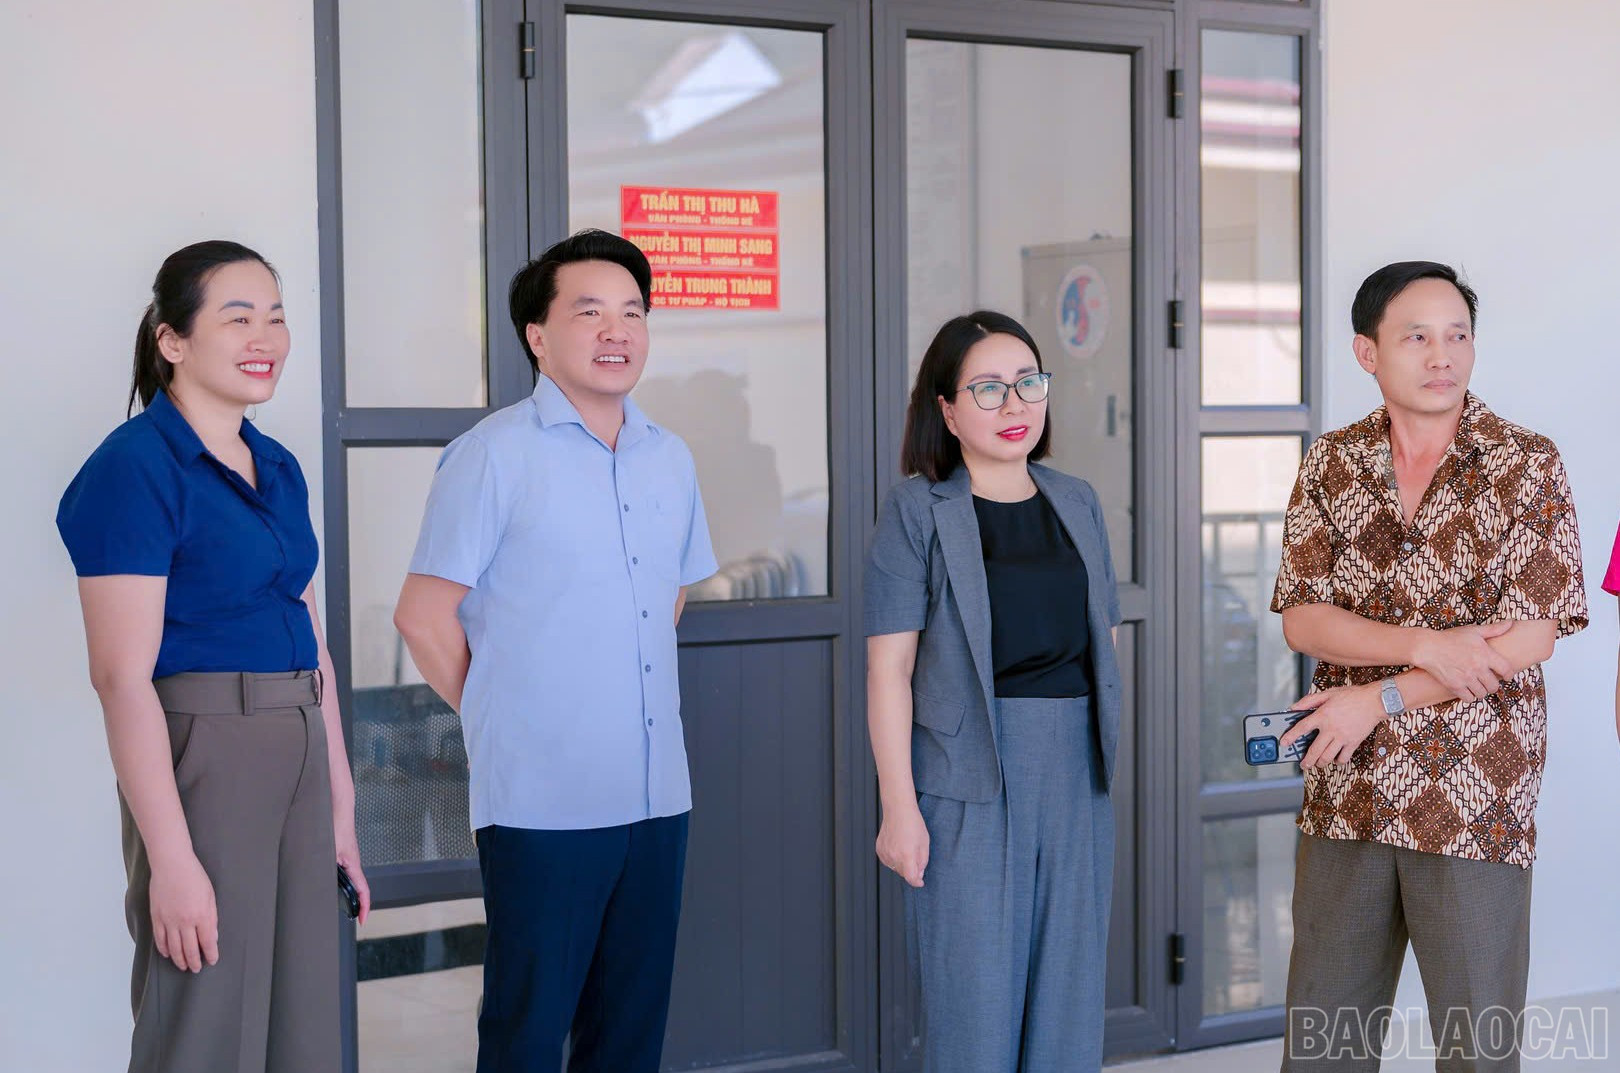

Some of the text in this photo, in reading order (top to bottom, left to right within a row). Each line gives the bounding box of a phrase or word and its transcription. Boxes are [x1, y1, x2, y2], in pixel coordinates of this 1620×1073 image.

[683, 196, 706, 215] THỊ
[709, 196, 736, 214] THU
[740, 195, 760, 214] HÀ
[682, 237, 702, 256] THỊ
[704, 237, 736, 254] MINH
[739, 238, 773, 255] SANG
[650, 271, 772, 295] UYỄN TRUNG THÀNH
